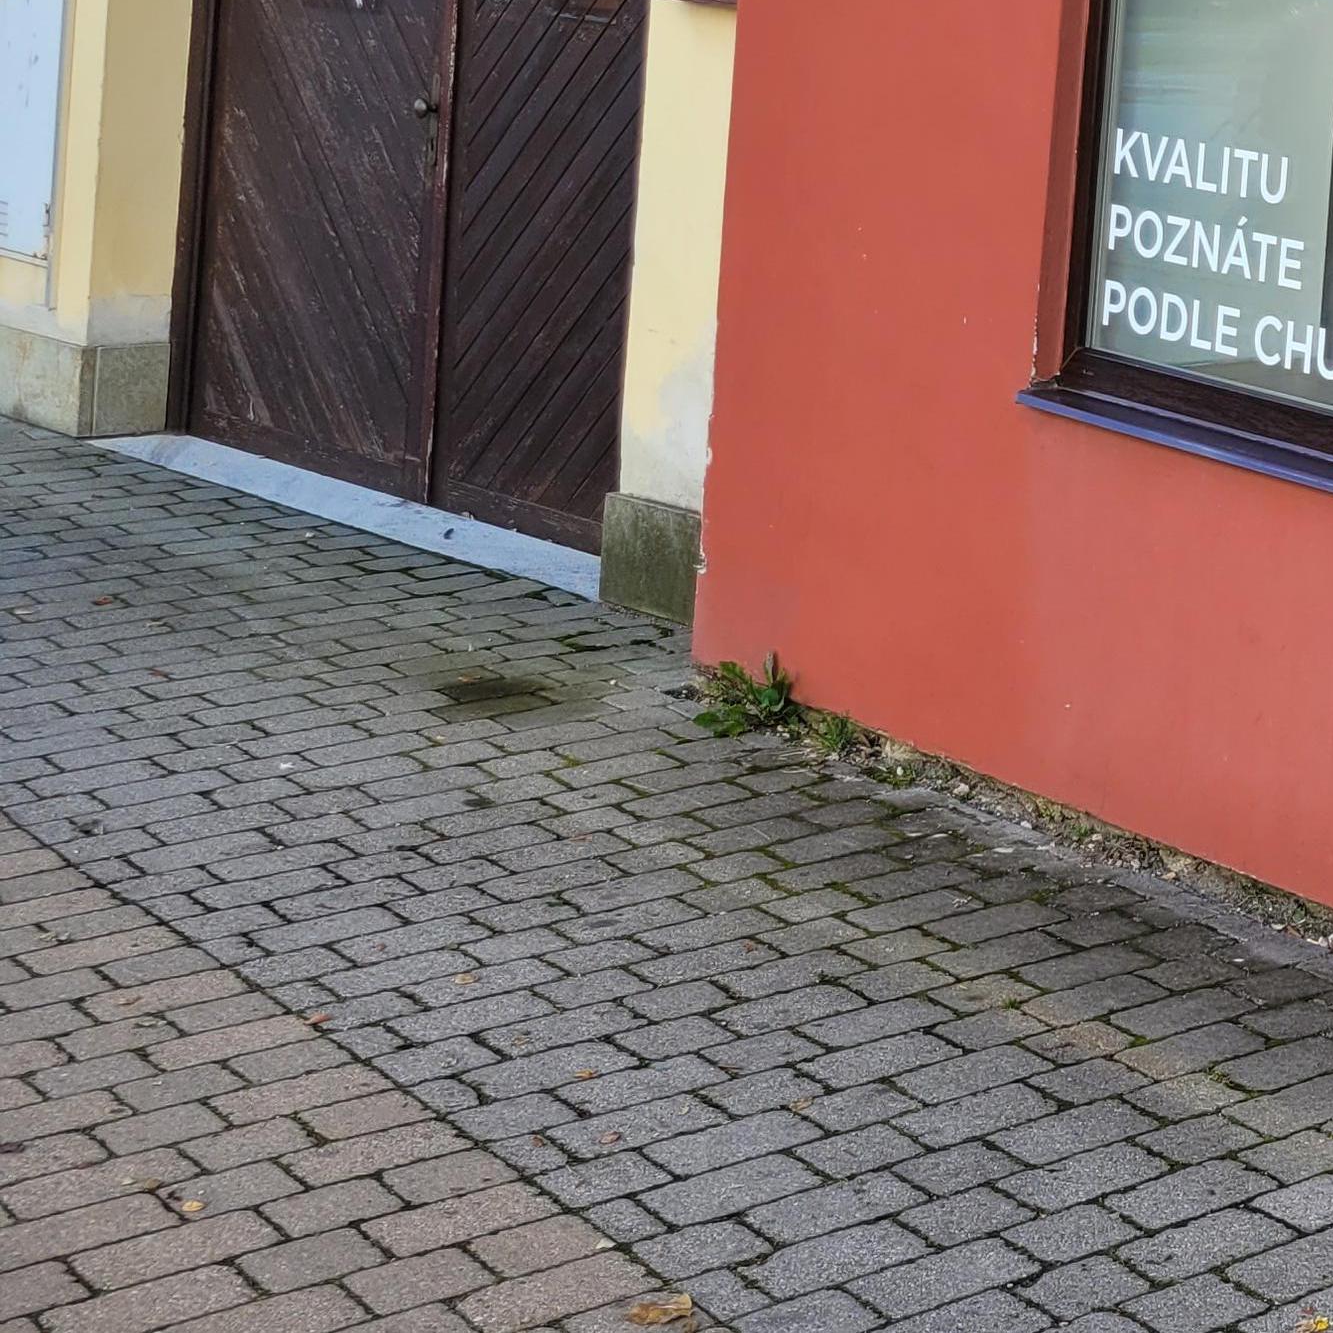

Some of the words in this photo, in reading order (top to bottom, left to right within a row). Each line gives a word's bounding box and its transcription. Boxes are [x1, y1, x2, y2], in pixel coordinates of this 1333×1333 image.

[1112, 128, 1289, 205] KVALITU
[1106, 204, 1305, 291] POZNÁTE
[1102, 278, 1242, 357] PODLE
